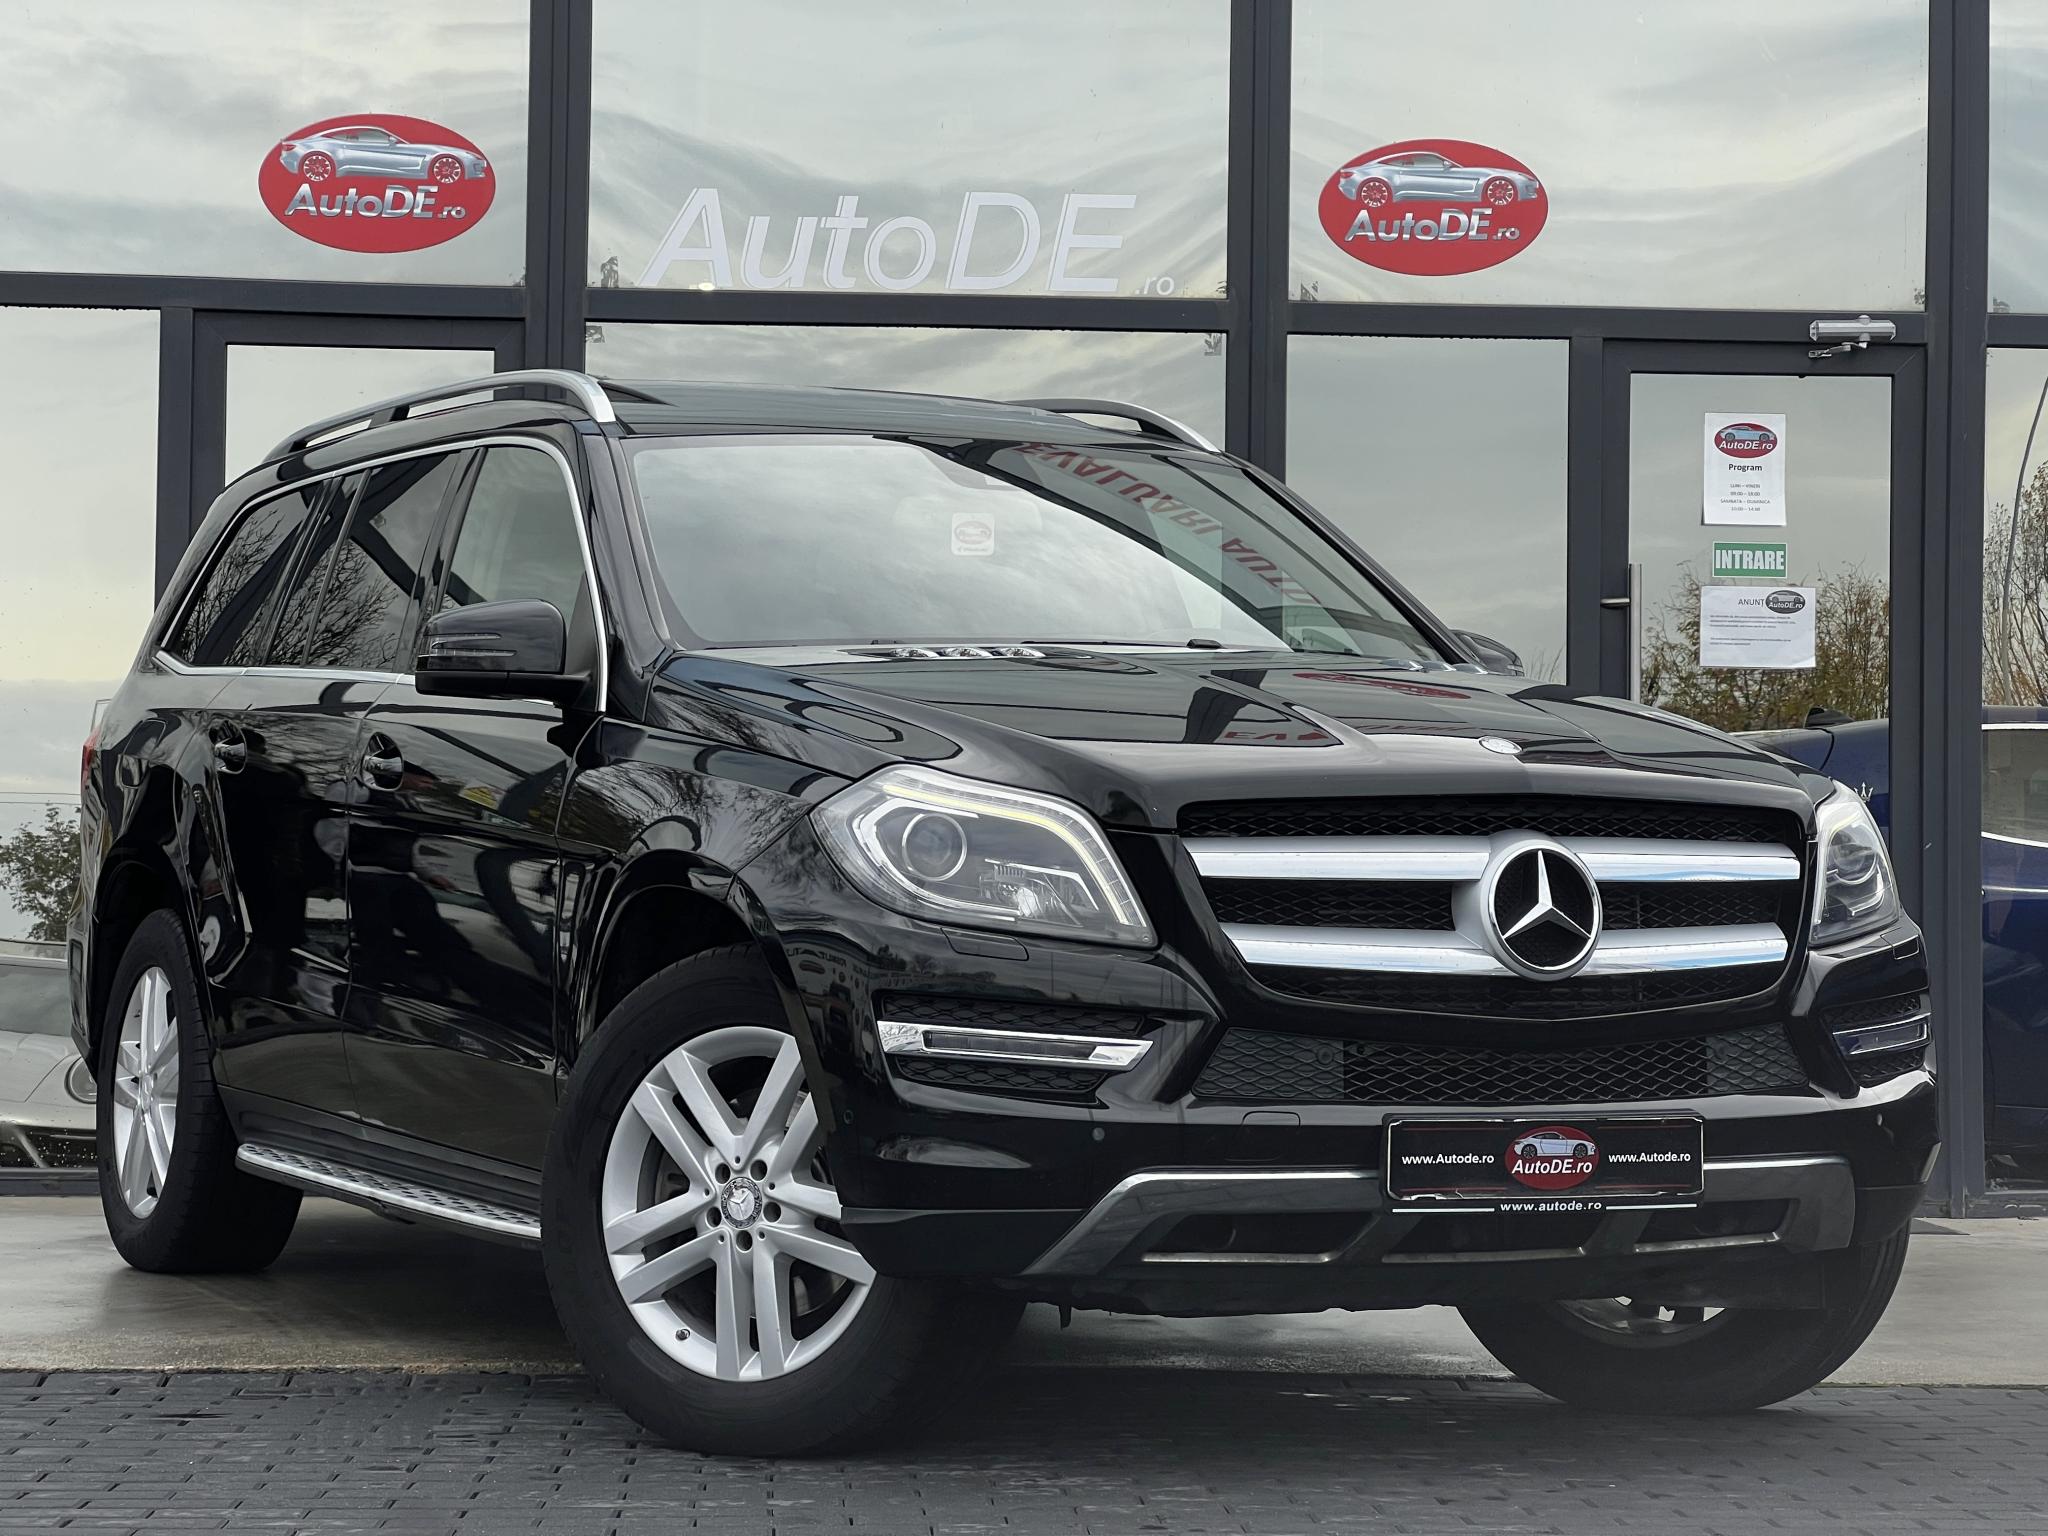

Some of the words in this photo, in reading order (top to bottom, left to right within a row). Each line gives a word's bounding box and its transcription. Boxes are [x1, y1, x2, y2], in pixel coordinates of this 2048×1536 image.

[284, 183, 466, 219] AutoDE.ro
[1344, 207, 1521, 242] AutoDE.ro
[1719, 440, 1774, 450] AutoDE.ro
[1728, 463, 1763, 473] Program
[1715, 549, 1785, 570] INTRARE
[1768, 601, 1803, 609] AutoDE.ro
[1402, 1152, 1495, 1165] www.Autode.ro
[1608, 1151, 1691, 1164] www.Autode.ro
[1511, 1158, 1593, 1175] AutoDE.ro
[1500, 1200, 1602, 1212] www.autode.ro
